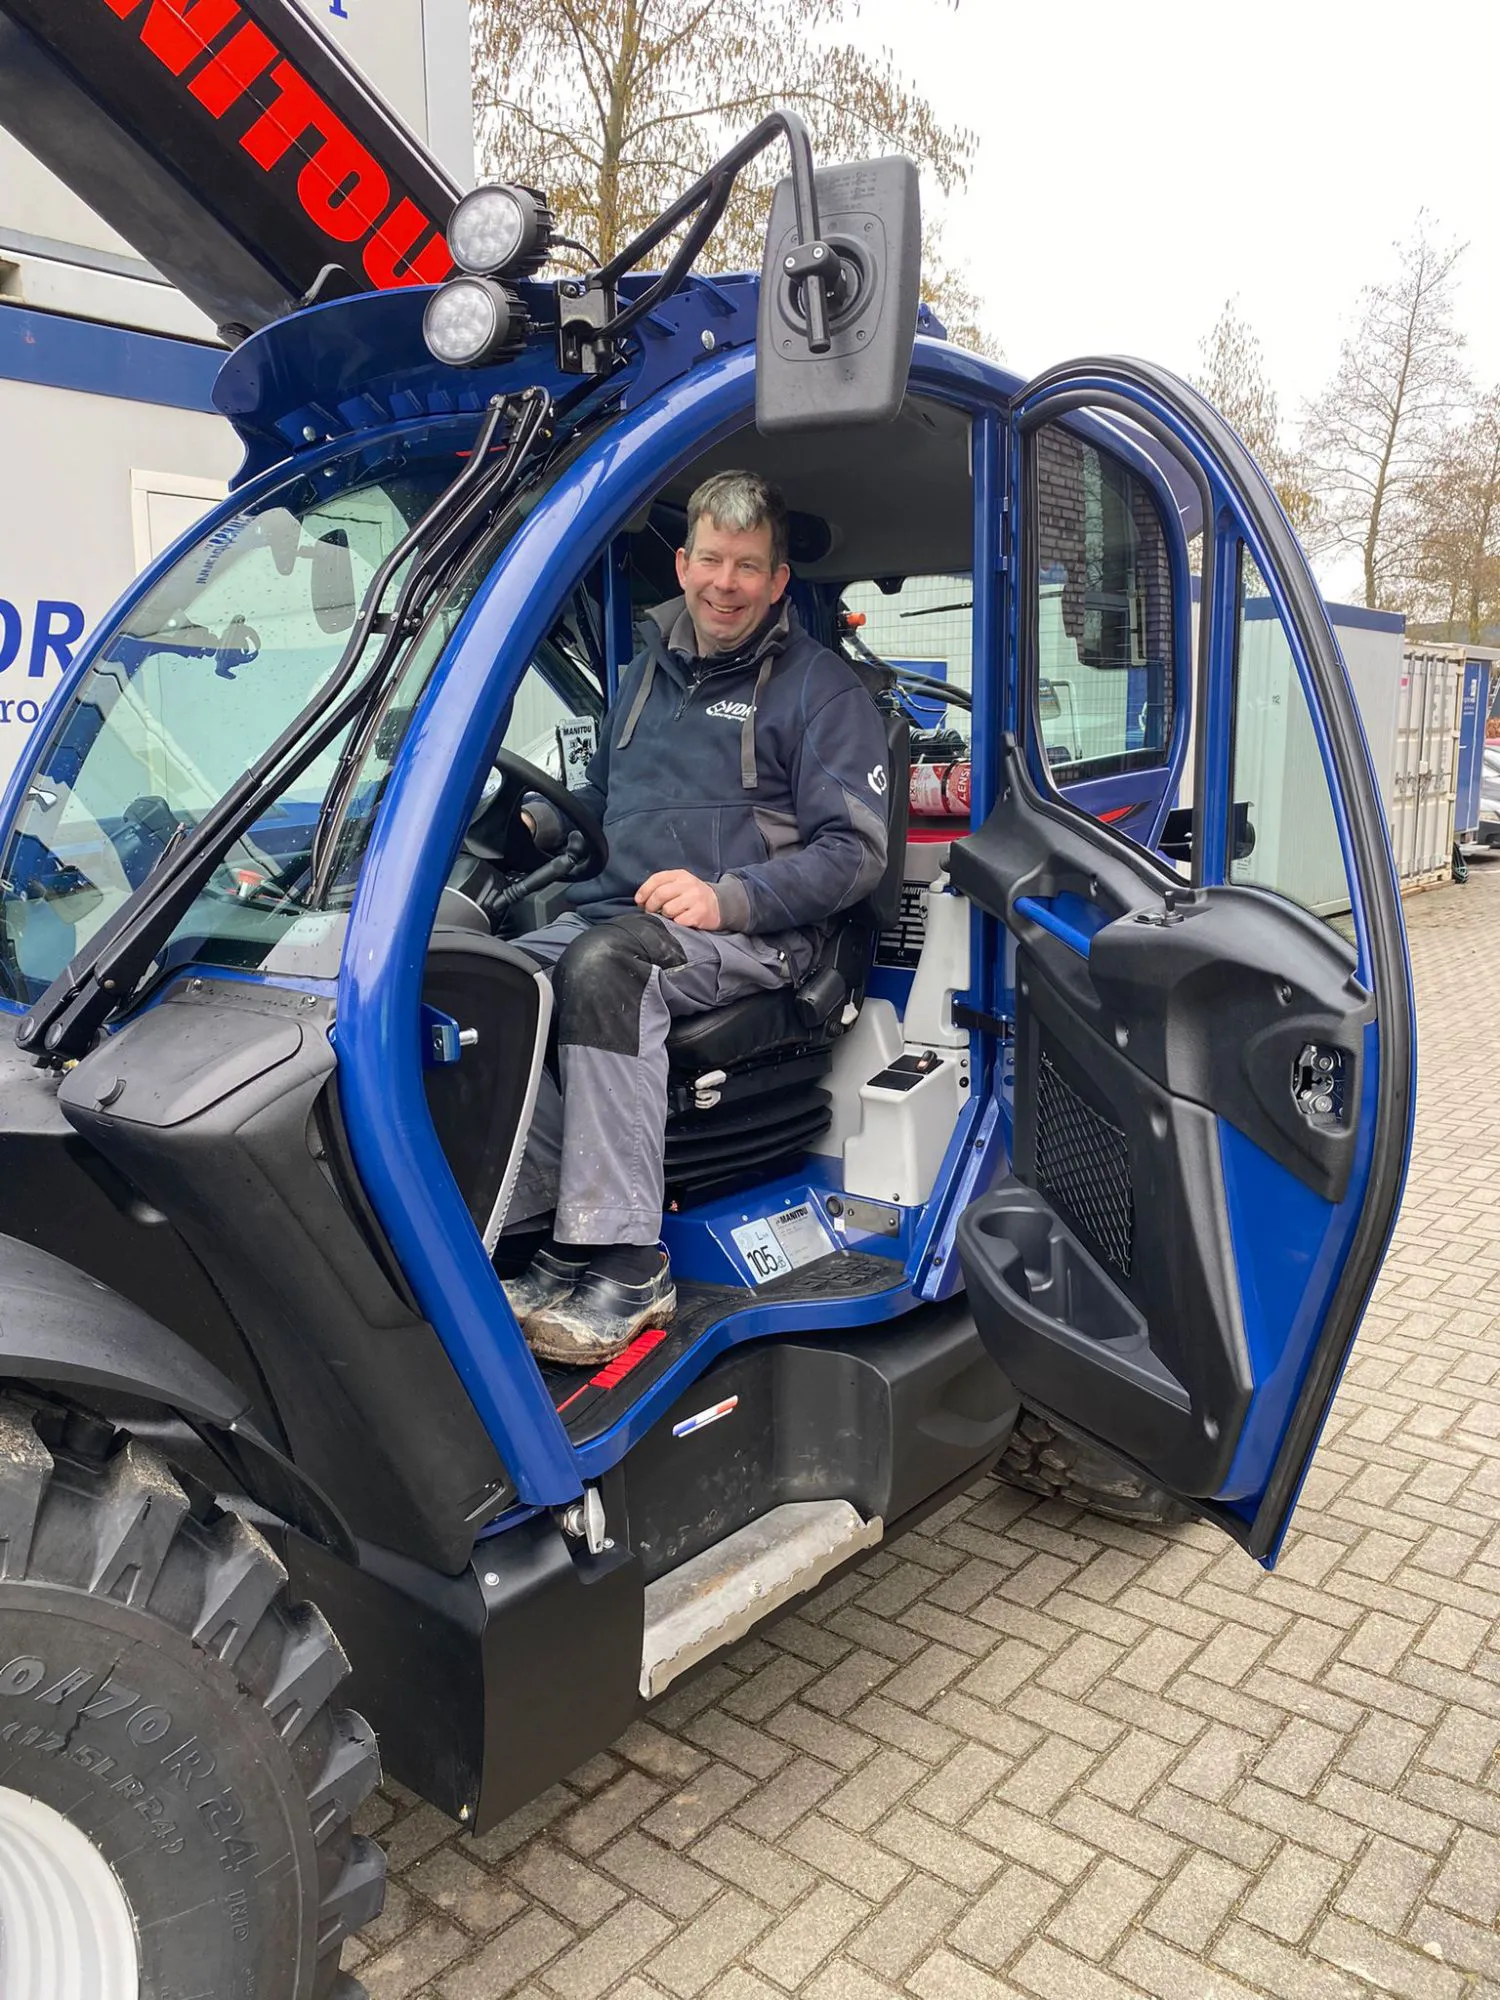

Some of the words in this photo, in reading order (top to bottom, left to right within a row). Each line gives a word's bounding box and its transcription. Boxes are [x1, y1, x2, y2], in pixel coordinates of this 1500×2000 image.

[0, 699, 48, 724] ro
[562, 725, 593, 736] MANITOU
[780, 1206, 809, 1225] MANITOU
[746, 1245, 779, 1277] 105
